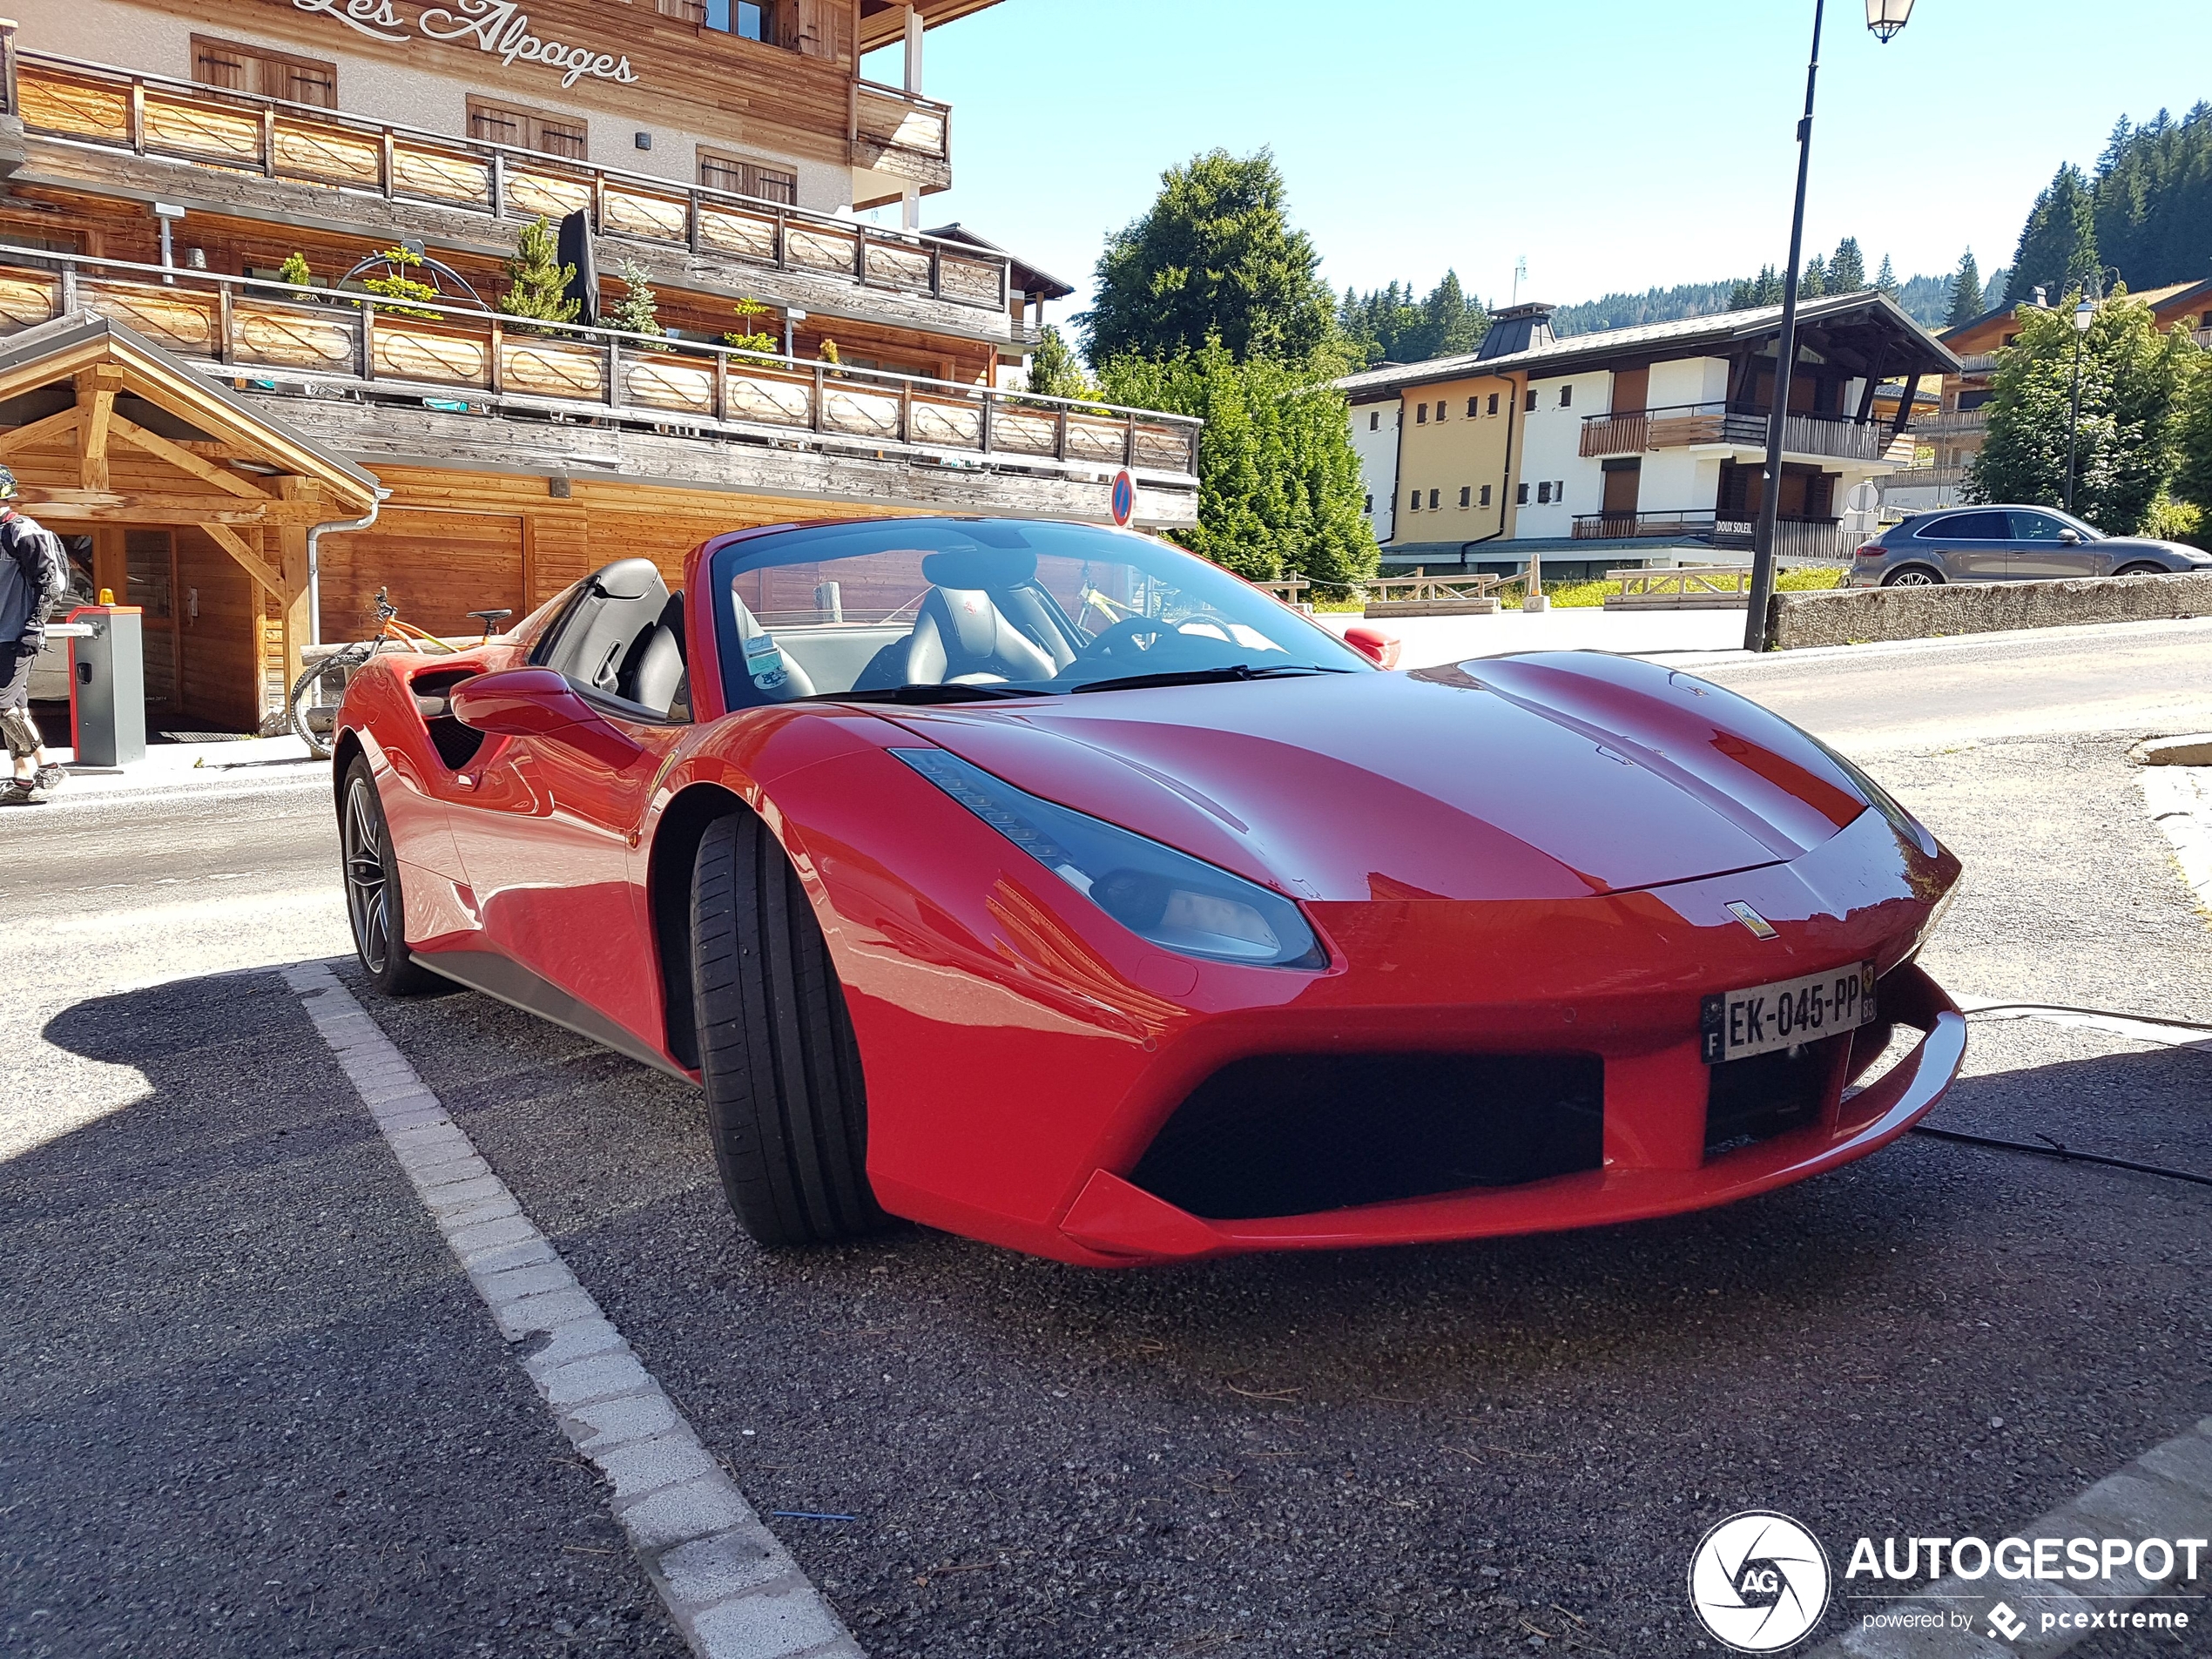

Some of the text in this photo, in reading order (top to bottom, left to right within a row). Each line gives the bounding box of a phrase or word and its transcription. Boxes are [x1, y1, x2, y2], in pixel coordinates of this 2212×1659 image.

[419, 0, 638, 88] Alpages
[1716, 521, 1752, 534] DOUX SOLEIL
[1708, 974, 1873, 1057] F EK-045-PP 83
